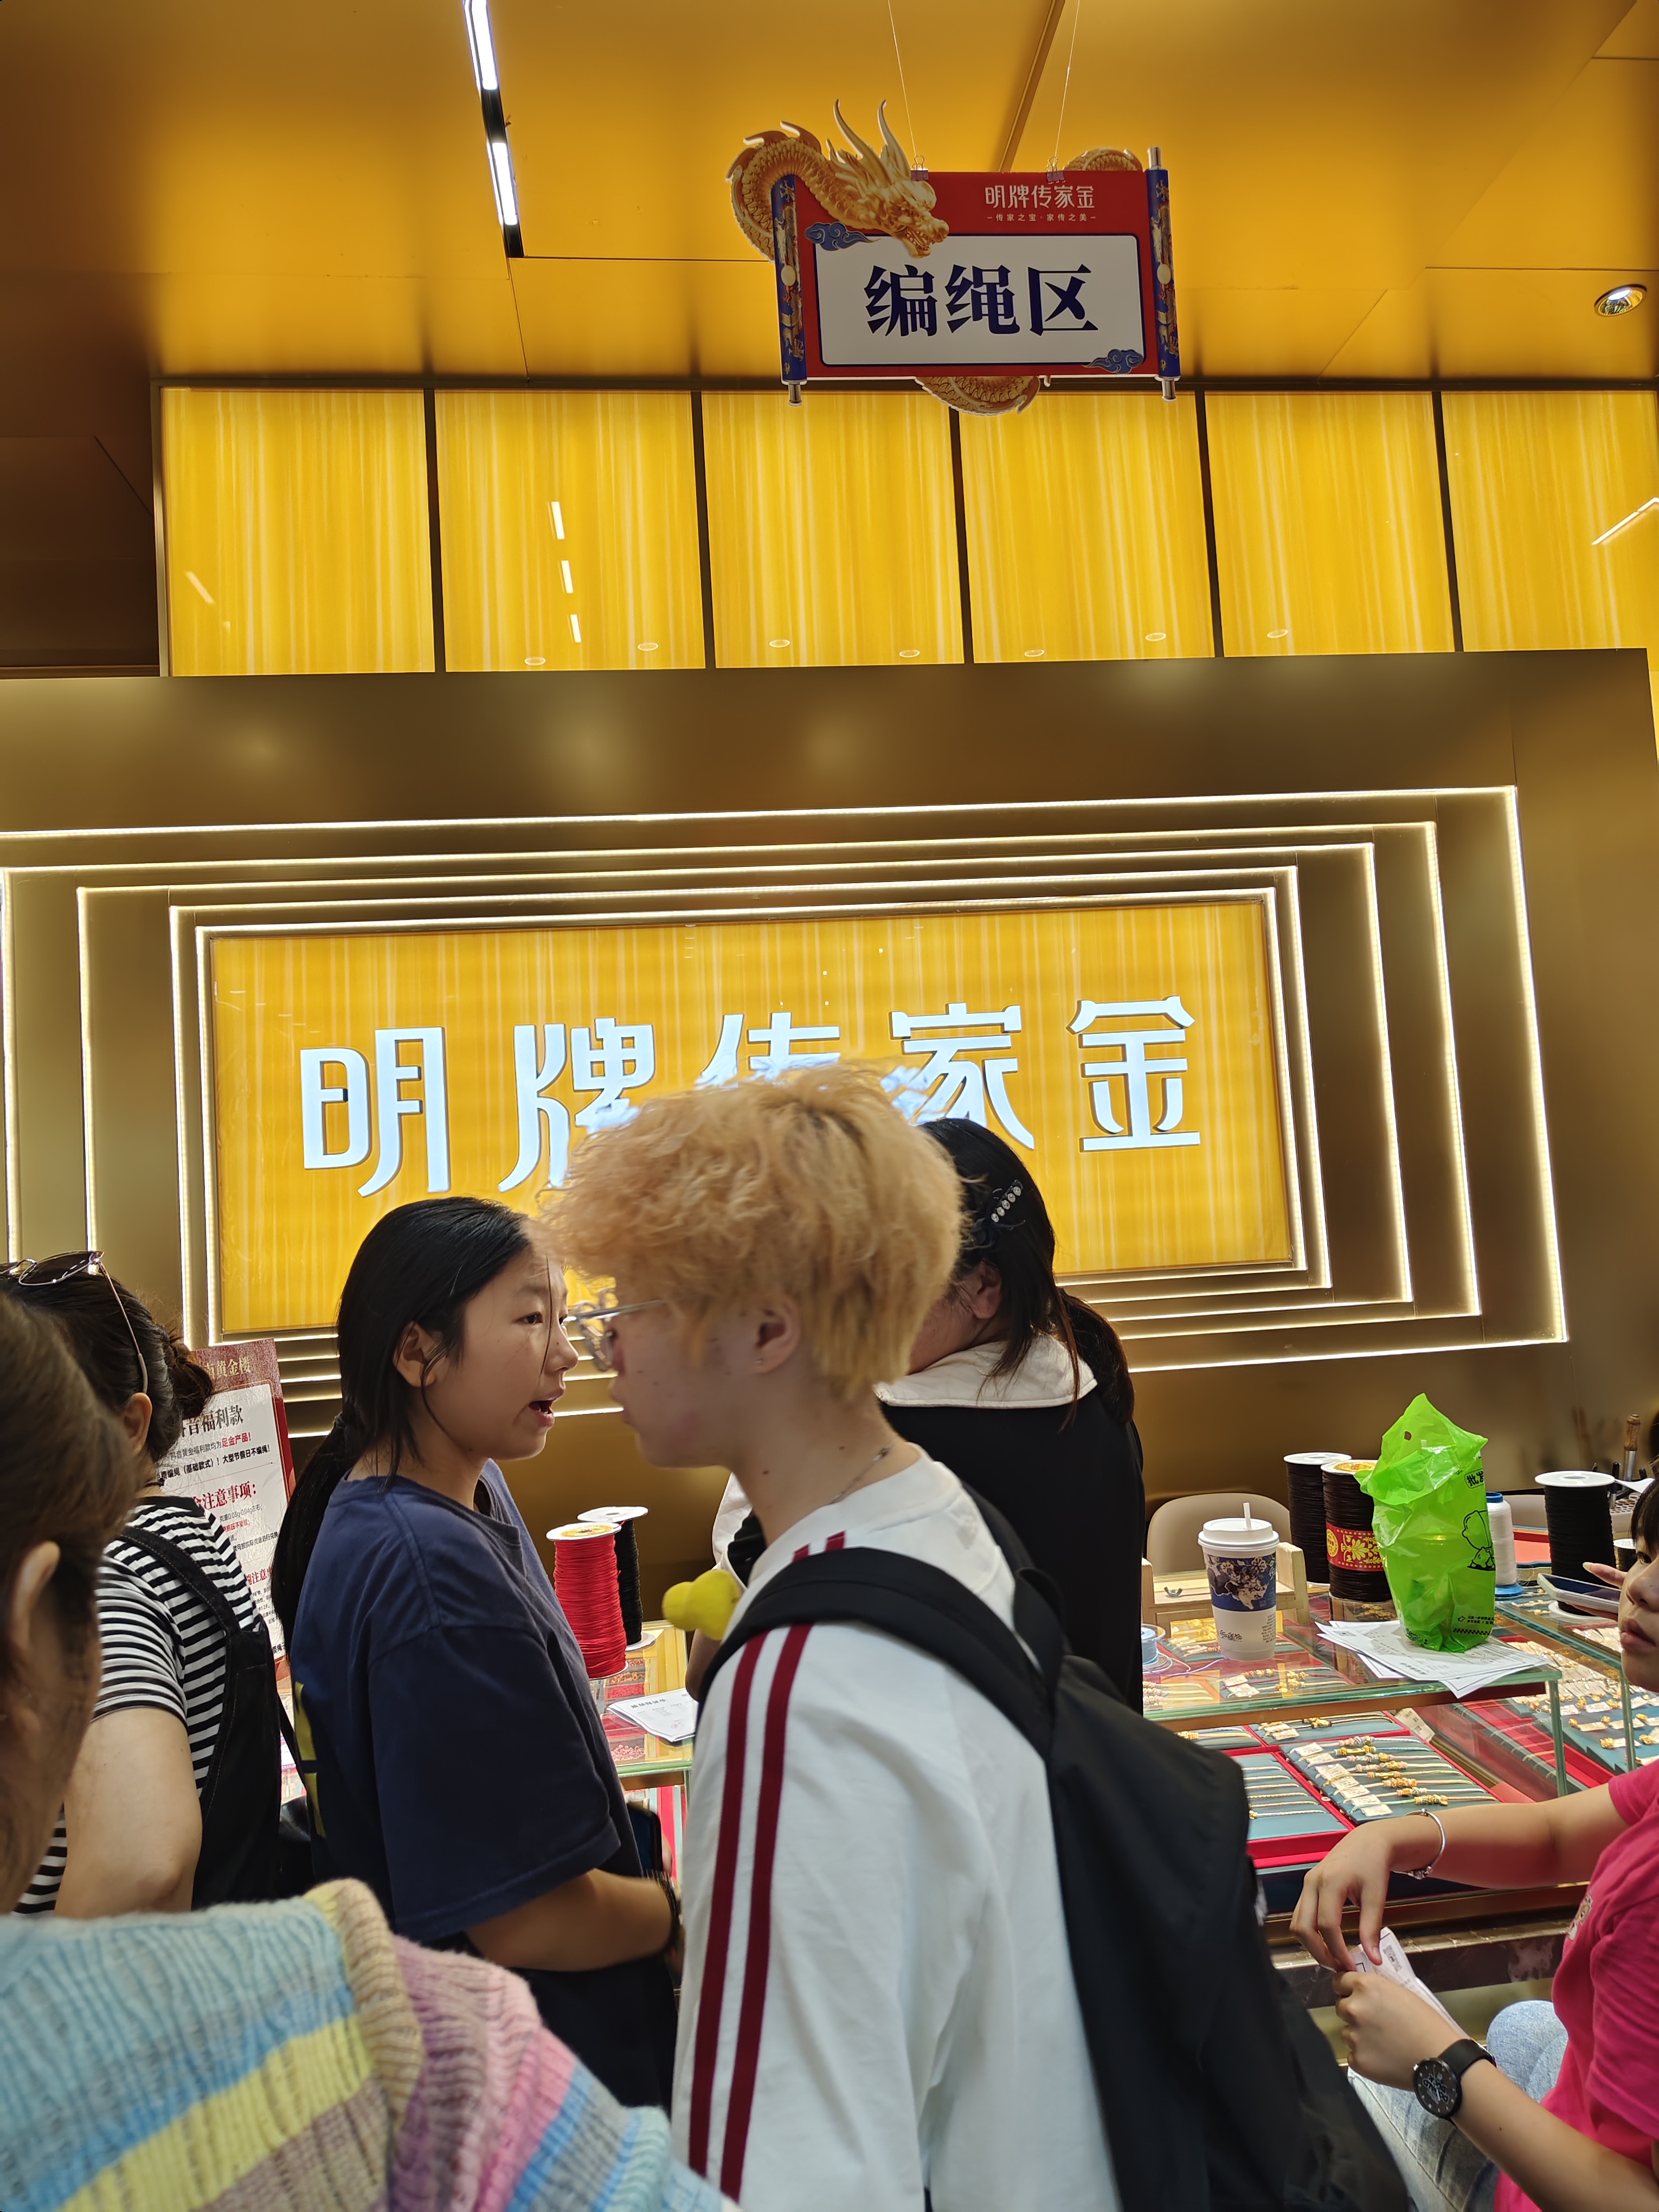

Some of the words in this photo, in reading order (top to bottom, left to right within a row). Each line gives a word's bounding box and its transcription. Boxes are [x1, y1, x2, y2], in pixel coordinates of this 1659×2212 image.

[985, 185, 1095, 208] 明牌传家金
[864, 265, 1099, 337] 编绳区
[182, 1405, 243, 1437] 音福利款
[194, 1481, 256, 1510] 注意事项：
